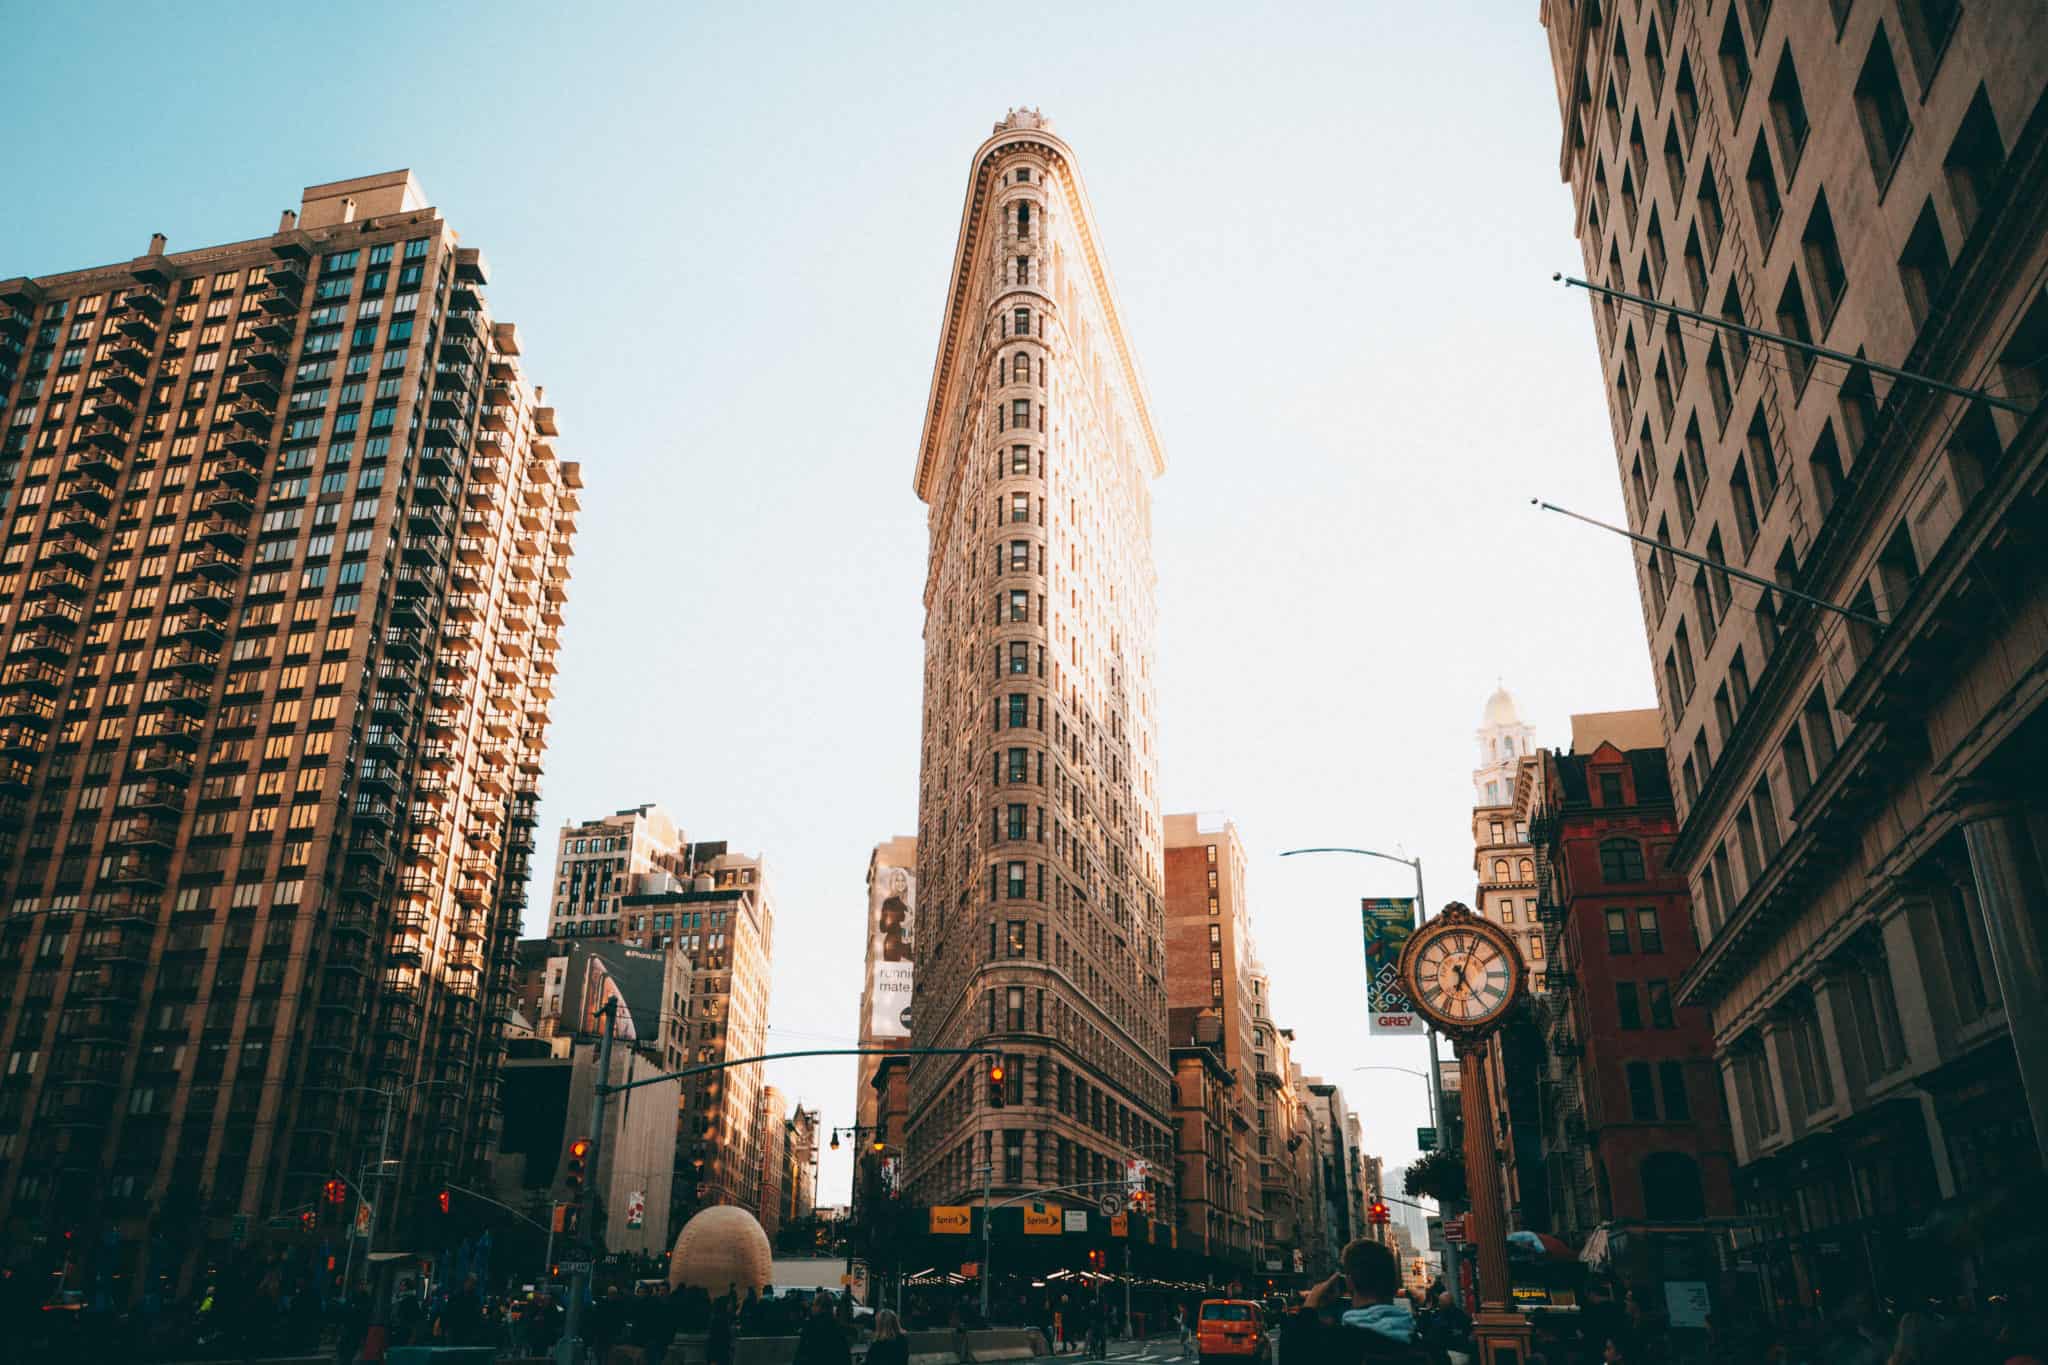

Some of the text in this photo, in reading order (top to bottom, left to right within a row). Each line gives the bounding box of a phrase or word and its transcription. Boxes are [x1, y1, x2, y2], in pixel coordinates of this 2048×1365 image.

[1378, 1016, 1413, 1026] GREY
[936, 1216, 959, 1225] Sprint
[1027, 1216, 1049, 1225] Sprint
